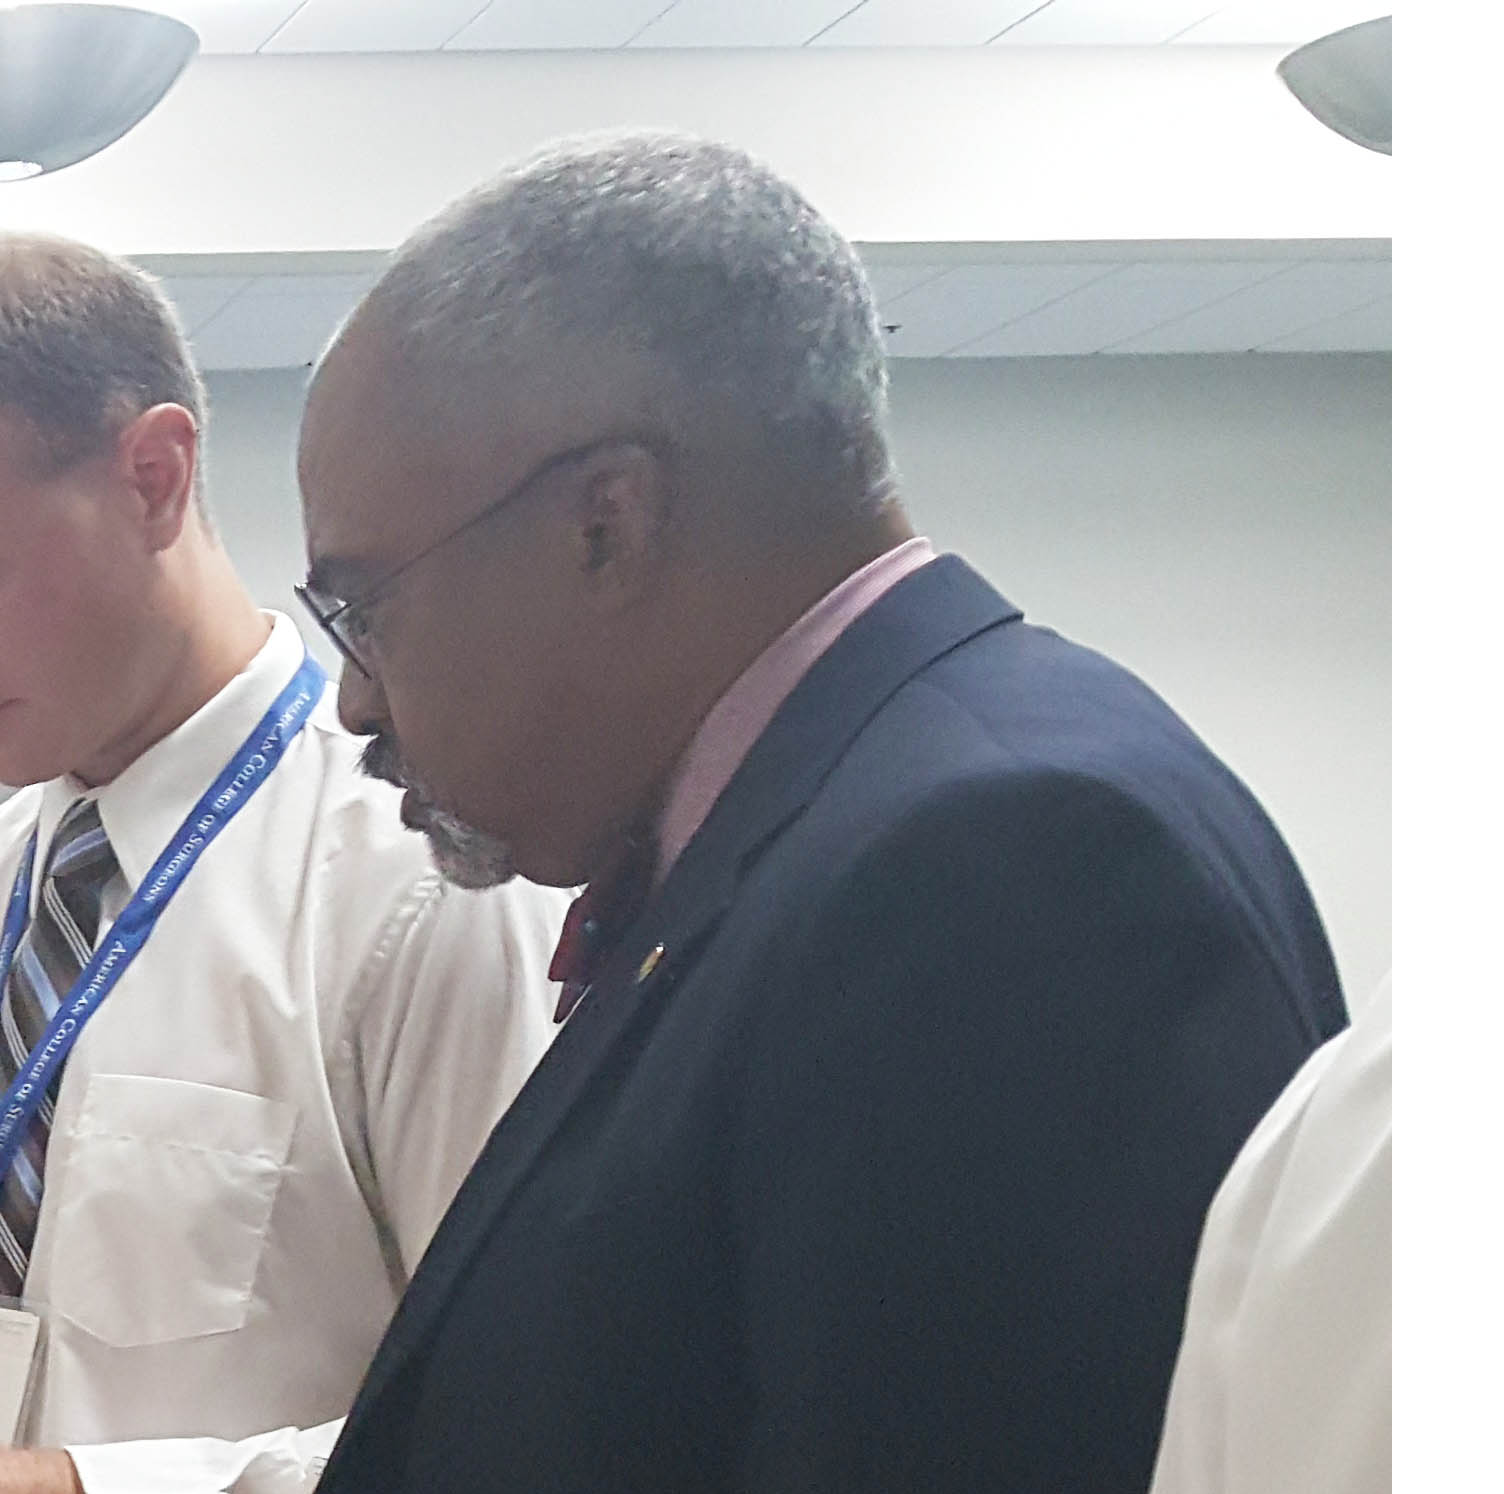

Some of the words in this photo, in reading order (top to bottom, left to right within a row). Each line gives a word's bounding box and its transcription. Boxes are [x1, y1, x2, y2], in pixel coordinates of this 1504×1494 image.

[213, 754, 266, 812] COLLEGE
[144, 833, 204, 902] SURGEONS
[71, 939, 126, 1015] AMERICAN
[28, 1018, 77, 1081] COLLEGE
